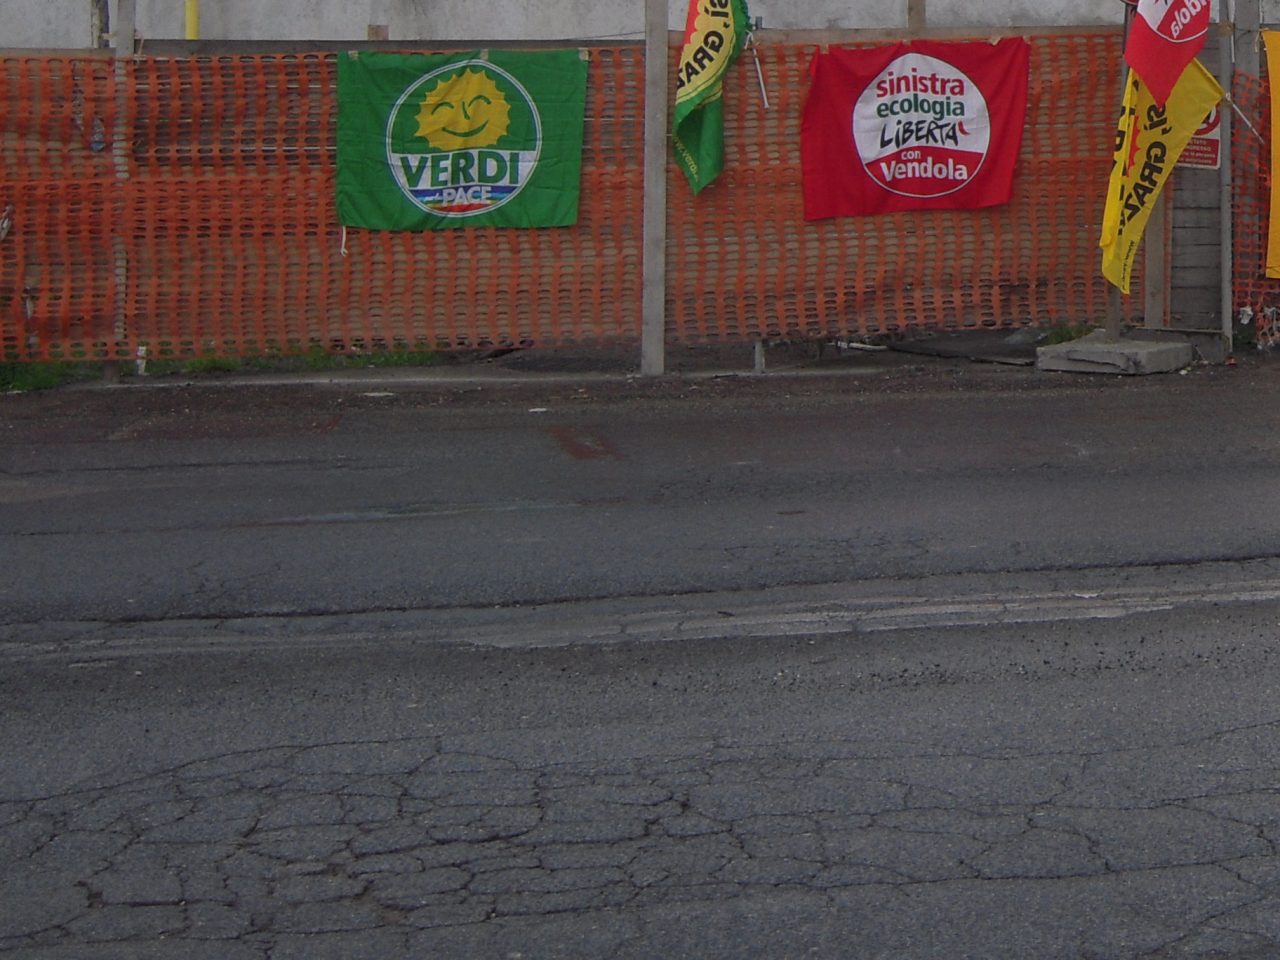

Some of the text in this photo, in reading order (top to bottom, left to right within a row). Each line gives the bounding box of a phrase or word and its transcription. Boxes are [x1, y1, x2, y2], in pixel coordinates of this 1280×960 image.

[876, 67, 965, 98] sinistra
[876, 93, 965, 121] ecologia
[901, 150, 922, 160] con
[400, 151, 520, 188] VERDI
[880, 156, 968, 182] Vendola
[441, 186, 492, 208] PACE
